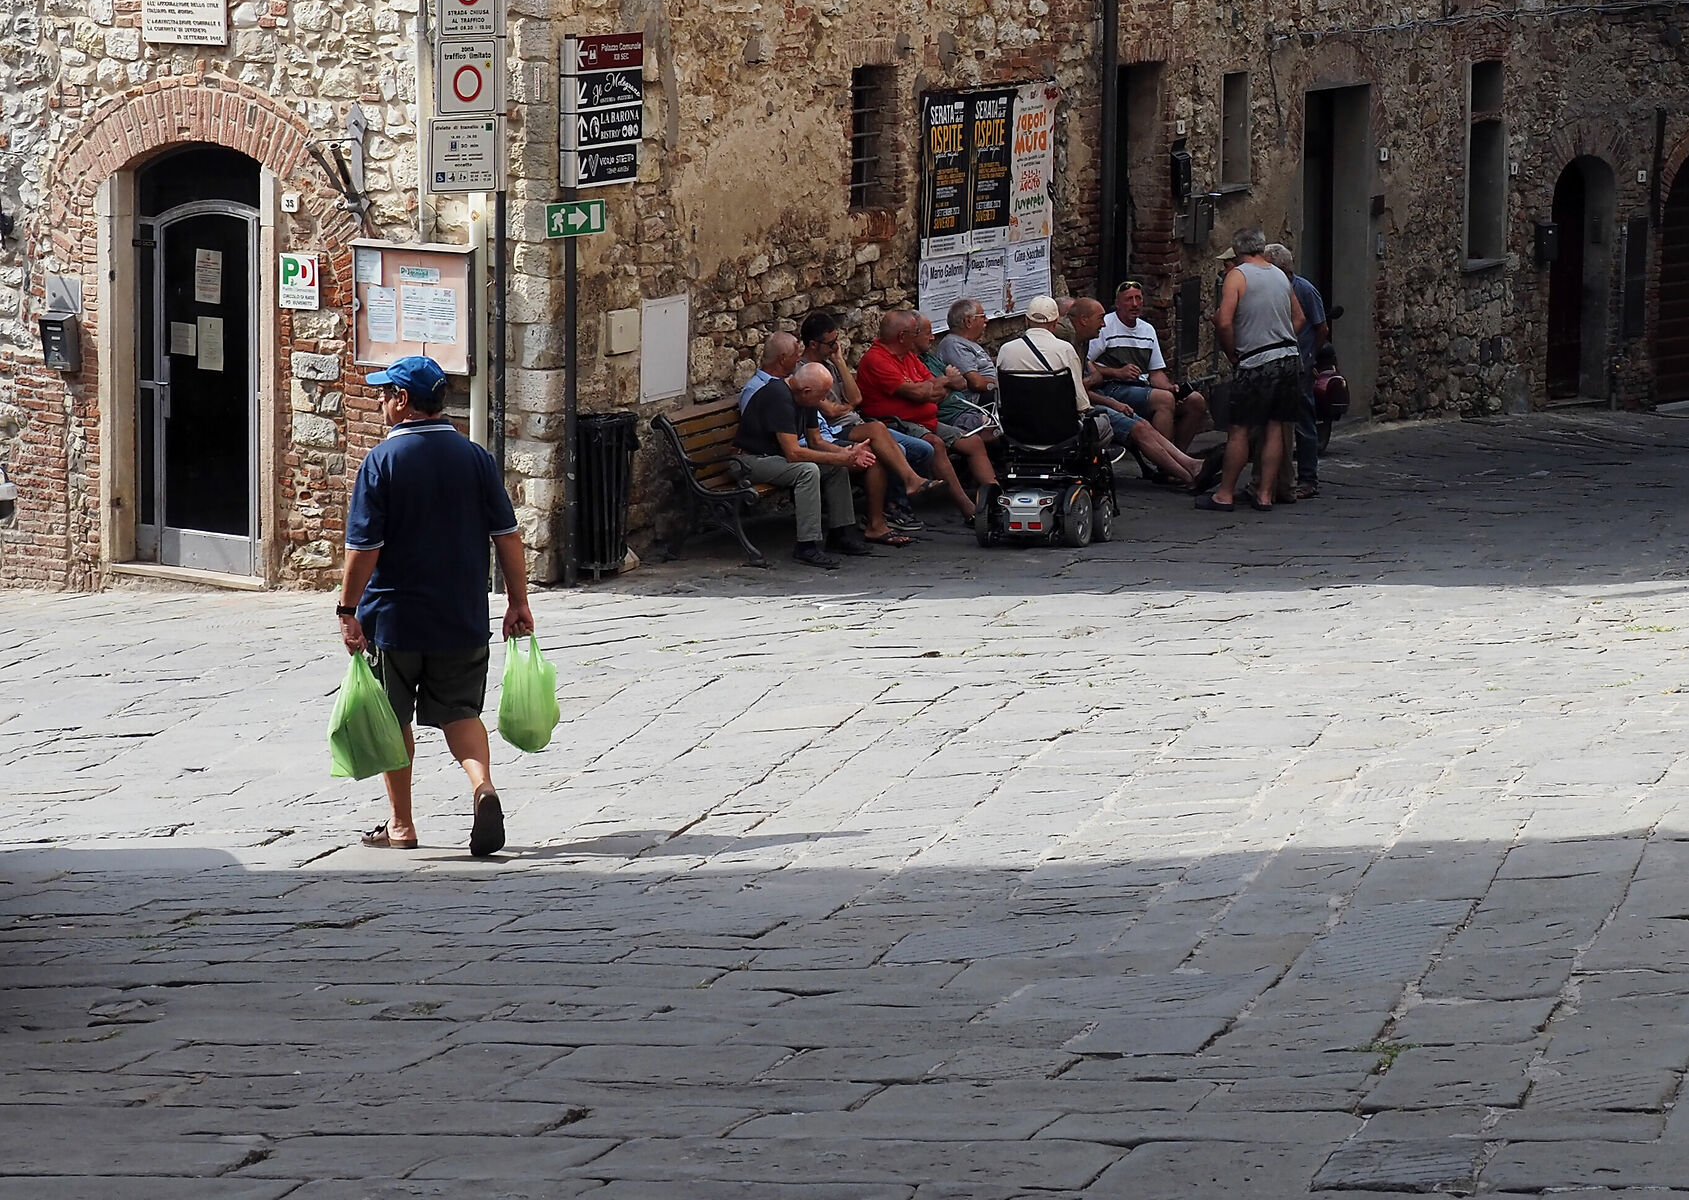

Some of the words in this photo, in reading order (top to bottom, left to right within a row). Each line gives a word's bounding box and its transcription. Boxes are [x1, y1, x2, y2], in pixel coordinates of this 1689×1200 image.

[600, 43, 619, 52] Palazzo
[619, 42, 642, 51] Comunale
[444, 52, 466, 60] traffico
[468, 51, 492, 59] limitato
[600, 112, 610, 125] LA
[610, 109, 640, 123] BARONA
[930, 104, 955, 126] SERATA
[974, 100, 998, 120] SERATA
[930, 123, 964, 155] OSPITE
[974, 118, 1006, 148] OSPITE
[1014, 249, 1026, 263] Gina
[282, 257, 316, 287] PD
[930, 265, 944, 280] Mario
[971, 259, 985, 271] Diego
